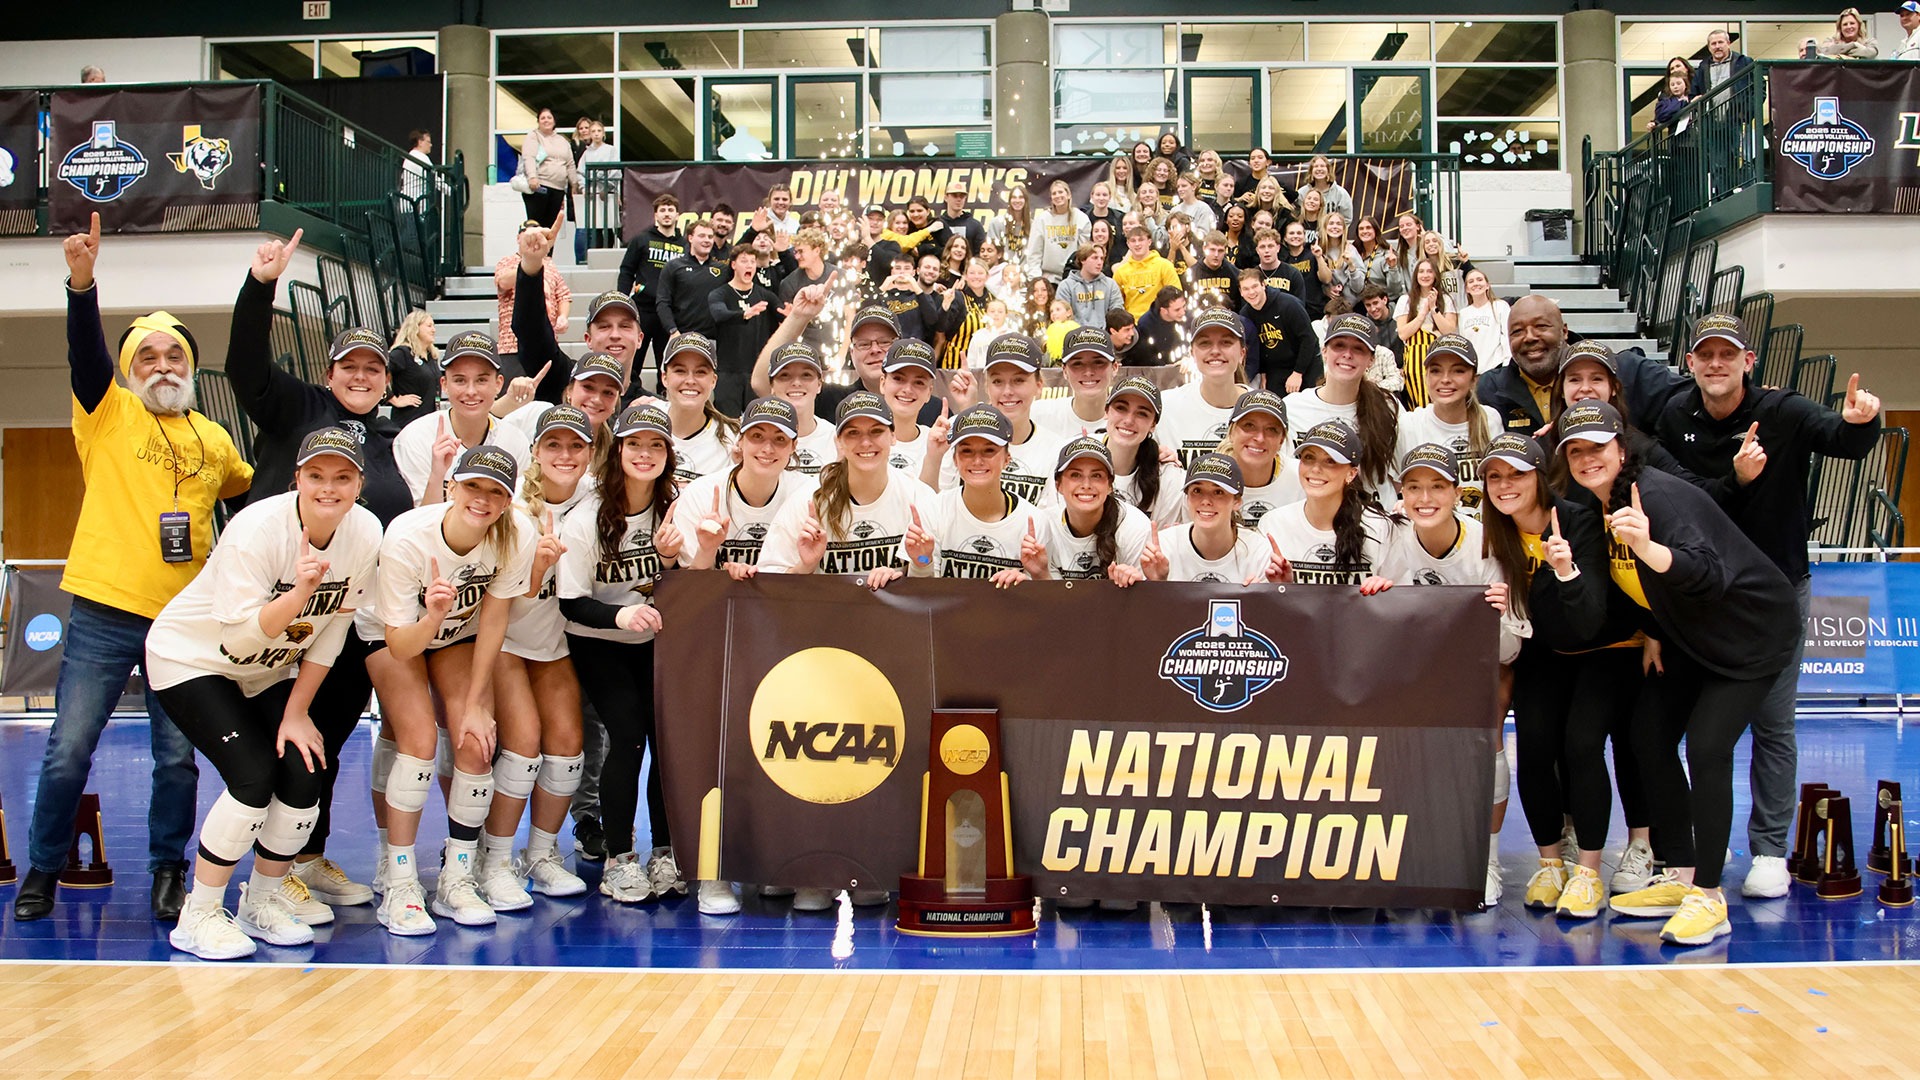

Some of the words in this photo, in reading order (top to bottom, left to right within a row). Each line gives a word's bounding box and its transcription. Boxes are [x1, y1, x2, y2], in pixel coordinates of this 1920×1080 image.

[309, 3, 326, 17] EXIT
[1784, 141, 1871, 153] CHAMPIONSHIP
[61, 162, 145, 177] CHAMPIONSHIP
[790, 169, 849, 205] DIII
[1345, 317, 1371, 327] National
[465, 335, 491, 344] National
[685, 334, 710, 345] National
[1080, 331, 1105, 339] National
[906, 343, 931, 355] National
[1002, 340, 1028, 349] National
[1255, 392, 1281, 402] National
[763, 400, 790, 411] National
[555, 408, 583, 418] National
[641, 409, 667, 421] National
[969, 413, 997, 421] National
[1569, 408, 1601, 418] National
[1317, 425, 1347, 438] National
[323, 431, 355, 444] National
[1495, 437, 1526, 447] National
[1078, 440, 1105, 450] National
[1418, 446, 1447, 457] National
[484, 452, 513, 469] National
[1203, 458, 1231, 469] National
[1897, 617, 1917, 637] III
[27, 631, 60, 642] NCAA
[1195, 641, 1226, 649] 2025
[1228, 641, 1253, 649] DIII
[1178, 649, 1218, 657] WOMEN'S
[1220, 650, 1269, 658] VOLLEYBALL
[1164, 659, 1283, 676] CHAMPIONSHIP
[763, 720, 897, 767] NCAA
[944, 750, 988, 765] NCAA
[1061, 729, 1382, 803] NATIONAL
[1041, 806, 1408, 881] CHAMPION
[926, 912, 961, 922] NATIONAL
[963, 912, 1005, 922] CHAMPION
